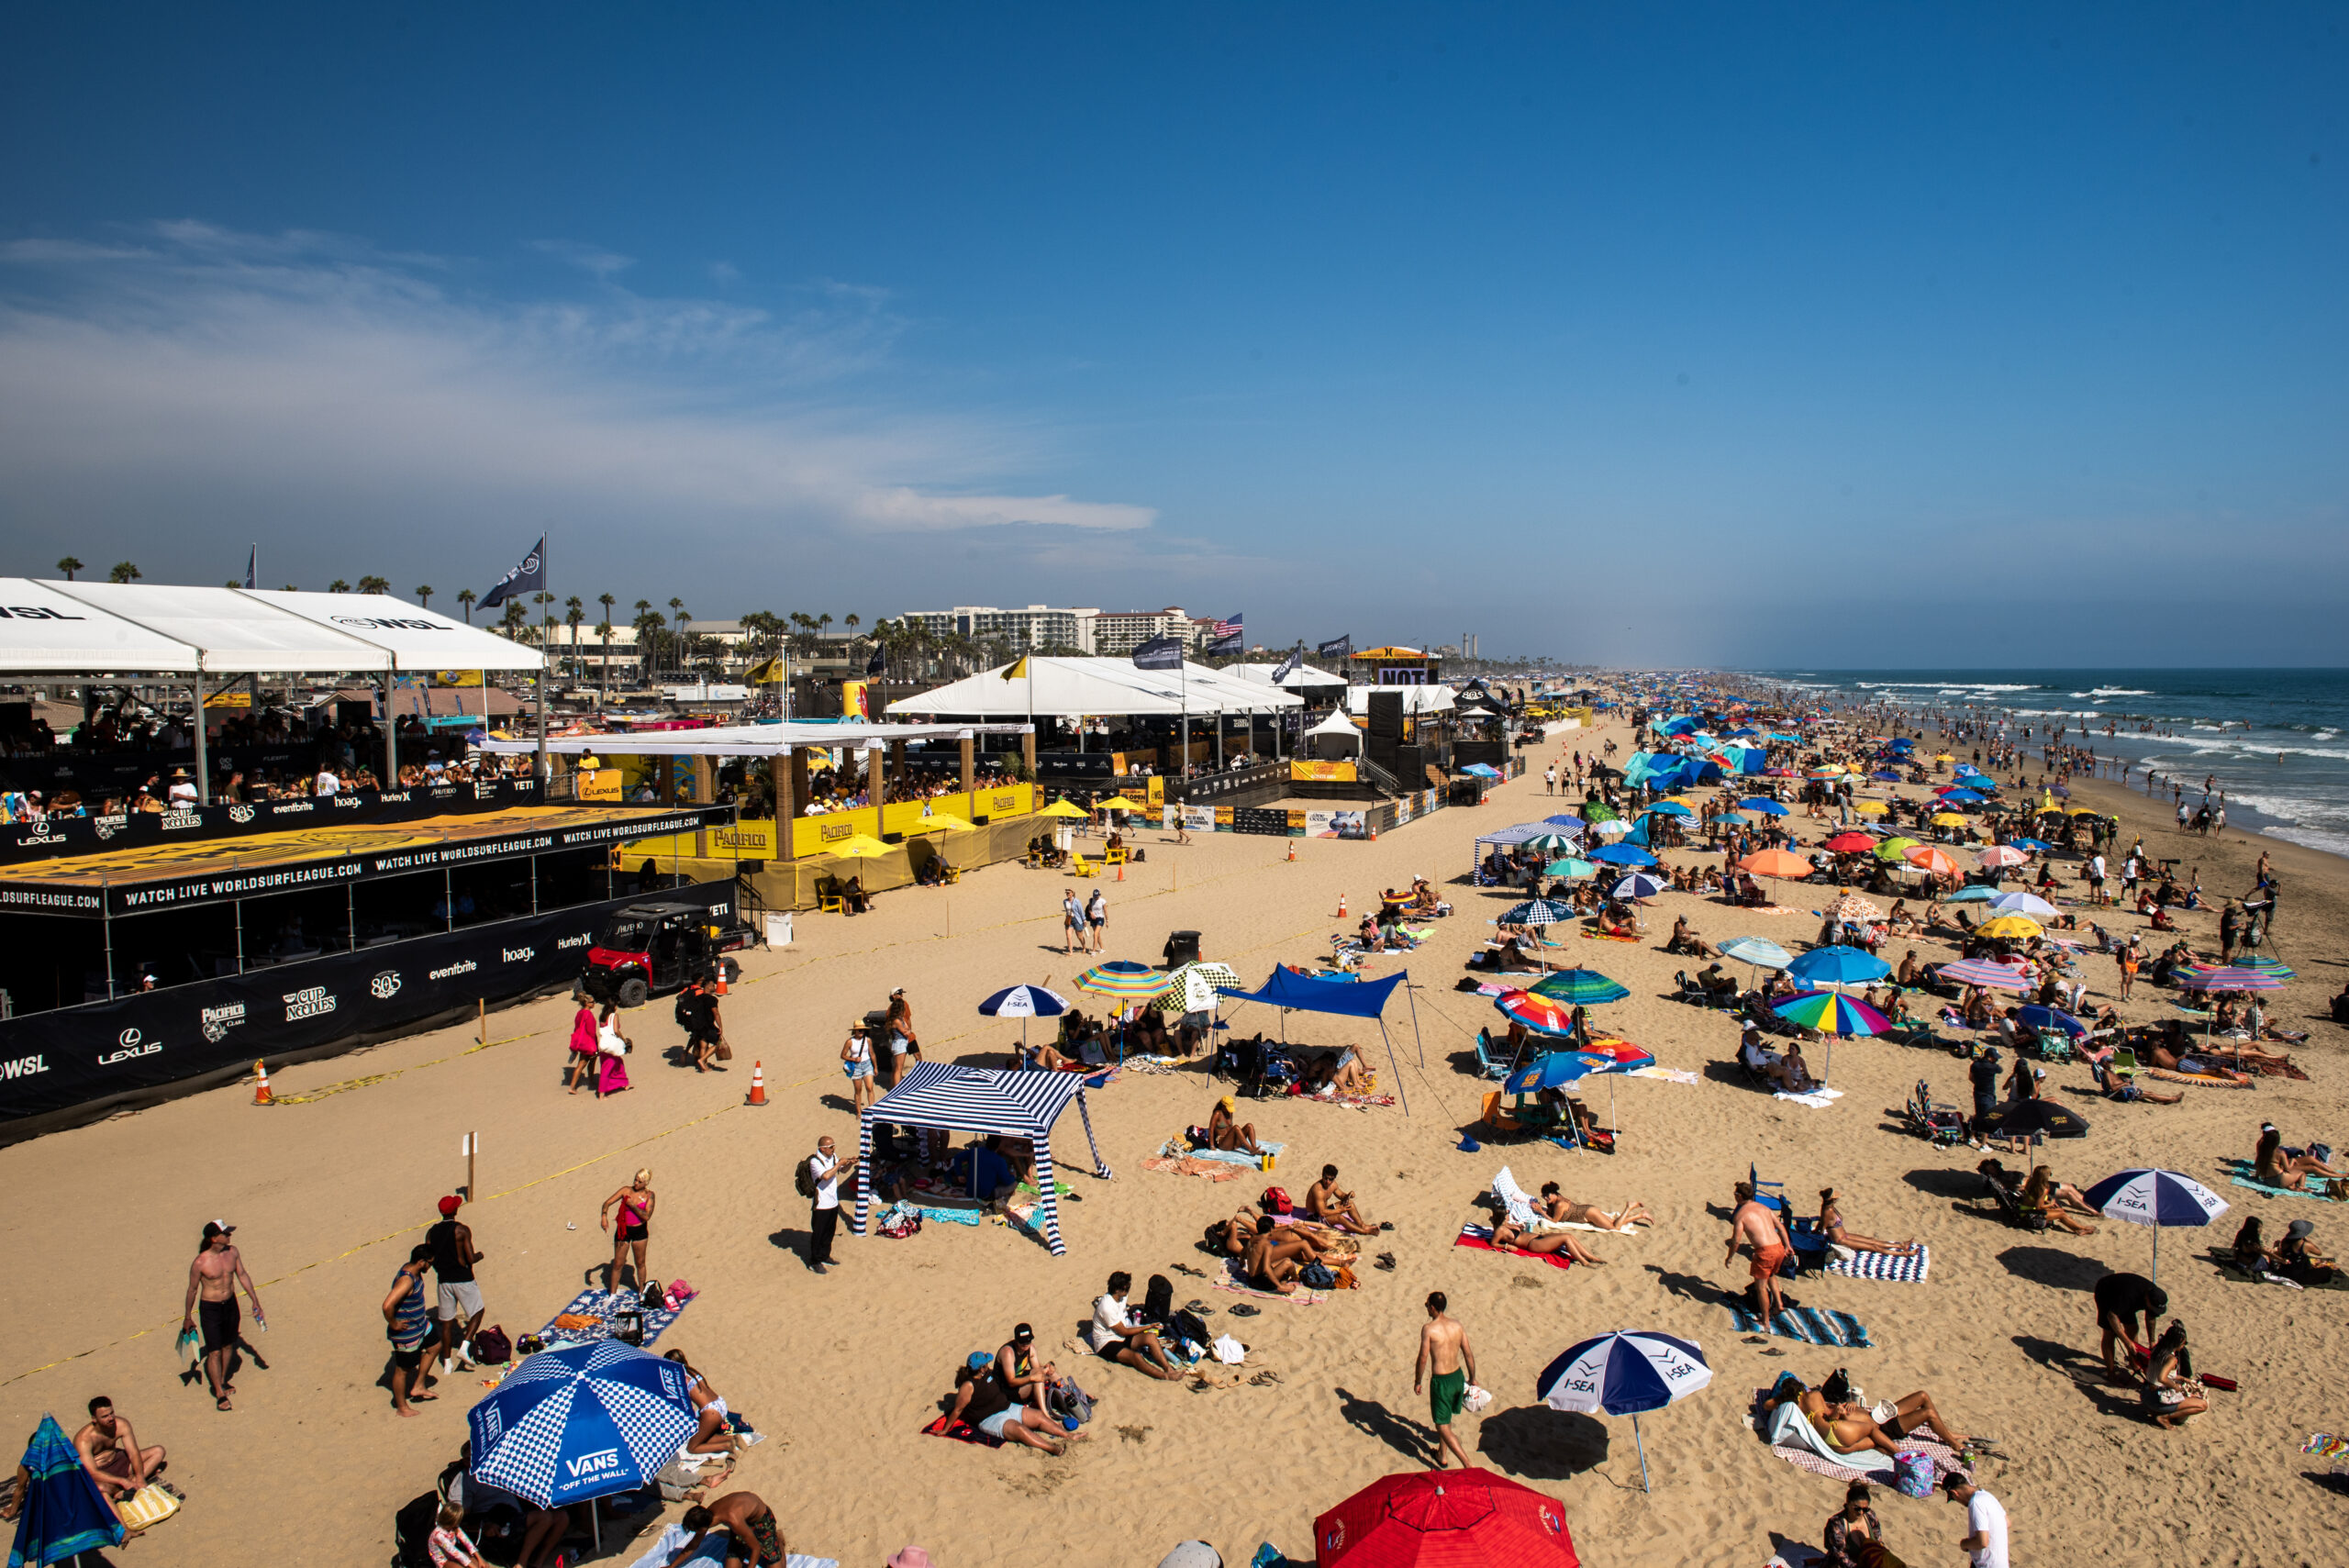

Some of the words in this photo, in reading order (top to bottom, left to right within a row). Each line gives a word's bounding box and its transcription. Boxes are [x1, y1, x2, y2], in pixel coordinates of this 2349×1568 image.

[362, 617, 454, 630] WSL
[1383, 670, 1425, 685] NOT
[1462, 691, 1484, 700] 805
[514, 780, 534, 791] YETI
[592, 787, 619, 795] LEXUS
[381, 792, 403, 802] Hurley
[229, 805, 255, 820] 805
[273, 801, 314, 814] eventbrite
[161, 816, 202, 830] NOODLES
[563, 832, 591, 844] WATCH
[594, 828, 611, 840] LIVE
[613, 817, 700, 837] WORLDSURFLEAGUE.COM
[17, 834, 66, 846] LEXUS
[715, 828, 767, 846] PACIFICO
[821, 824, 852, 841] PACIFICO
[375, 855, 411, 871] WATCH
[415, 851, 438, 865] LIVE
[440, 837, 552, 861] WORLDSURFLEAGUE.COM
[126, 887, 175, 906] WATCH
[180, 884, 207, 899] LIVE
[212, 863, 362, 894] WORLDSURFLEAGUE.COM
[558, 936, 584, 950] Hurley
[429, 960, 477, 980] eventbrite
[371, 973, 402, 995] 805
[296, 986, 326, 1004] CUP
[201, 1003, 245, 1024] PACIFICO
[286, 995, 337, 1021] NOODLES
[97, 1041, 162, 1065] LEXUS
[4, 1054, 50, 1080] WSL
[2116, 1197, 2148, 1211] I-SEA
[1664, 1362, 1696, 1381] I-SEA
[659, 1364, 679, 1400] VANS
[1564, 1378, 1596, 1394] I-SEA
[484, 1399, 502, 1441] VANS
[566, 1448, 618, 1477] VANS
[559, 1481, 581, 1492] "OFF
[583, 1475, 600, 1485] THE
[602, 1469, 629, 1480] WALL"
